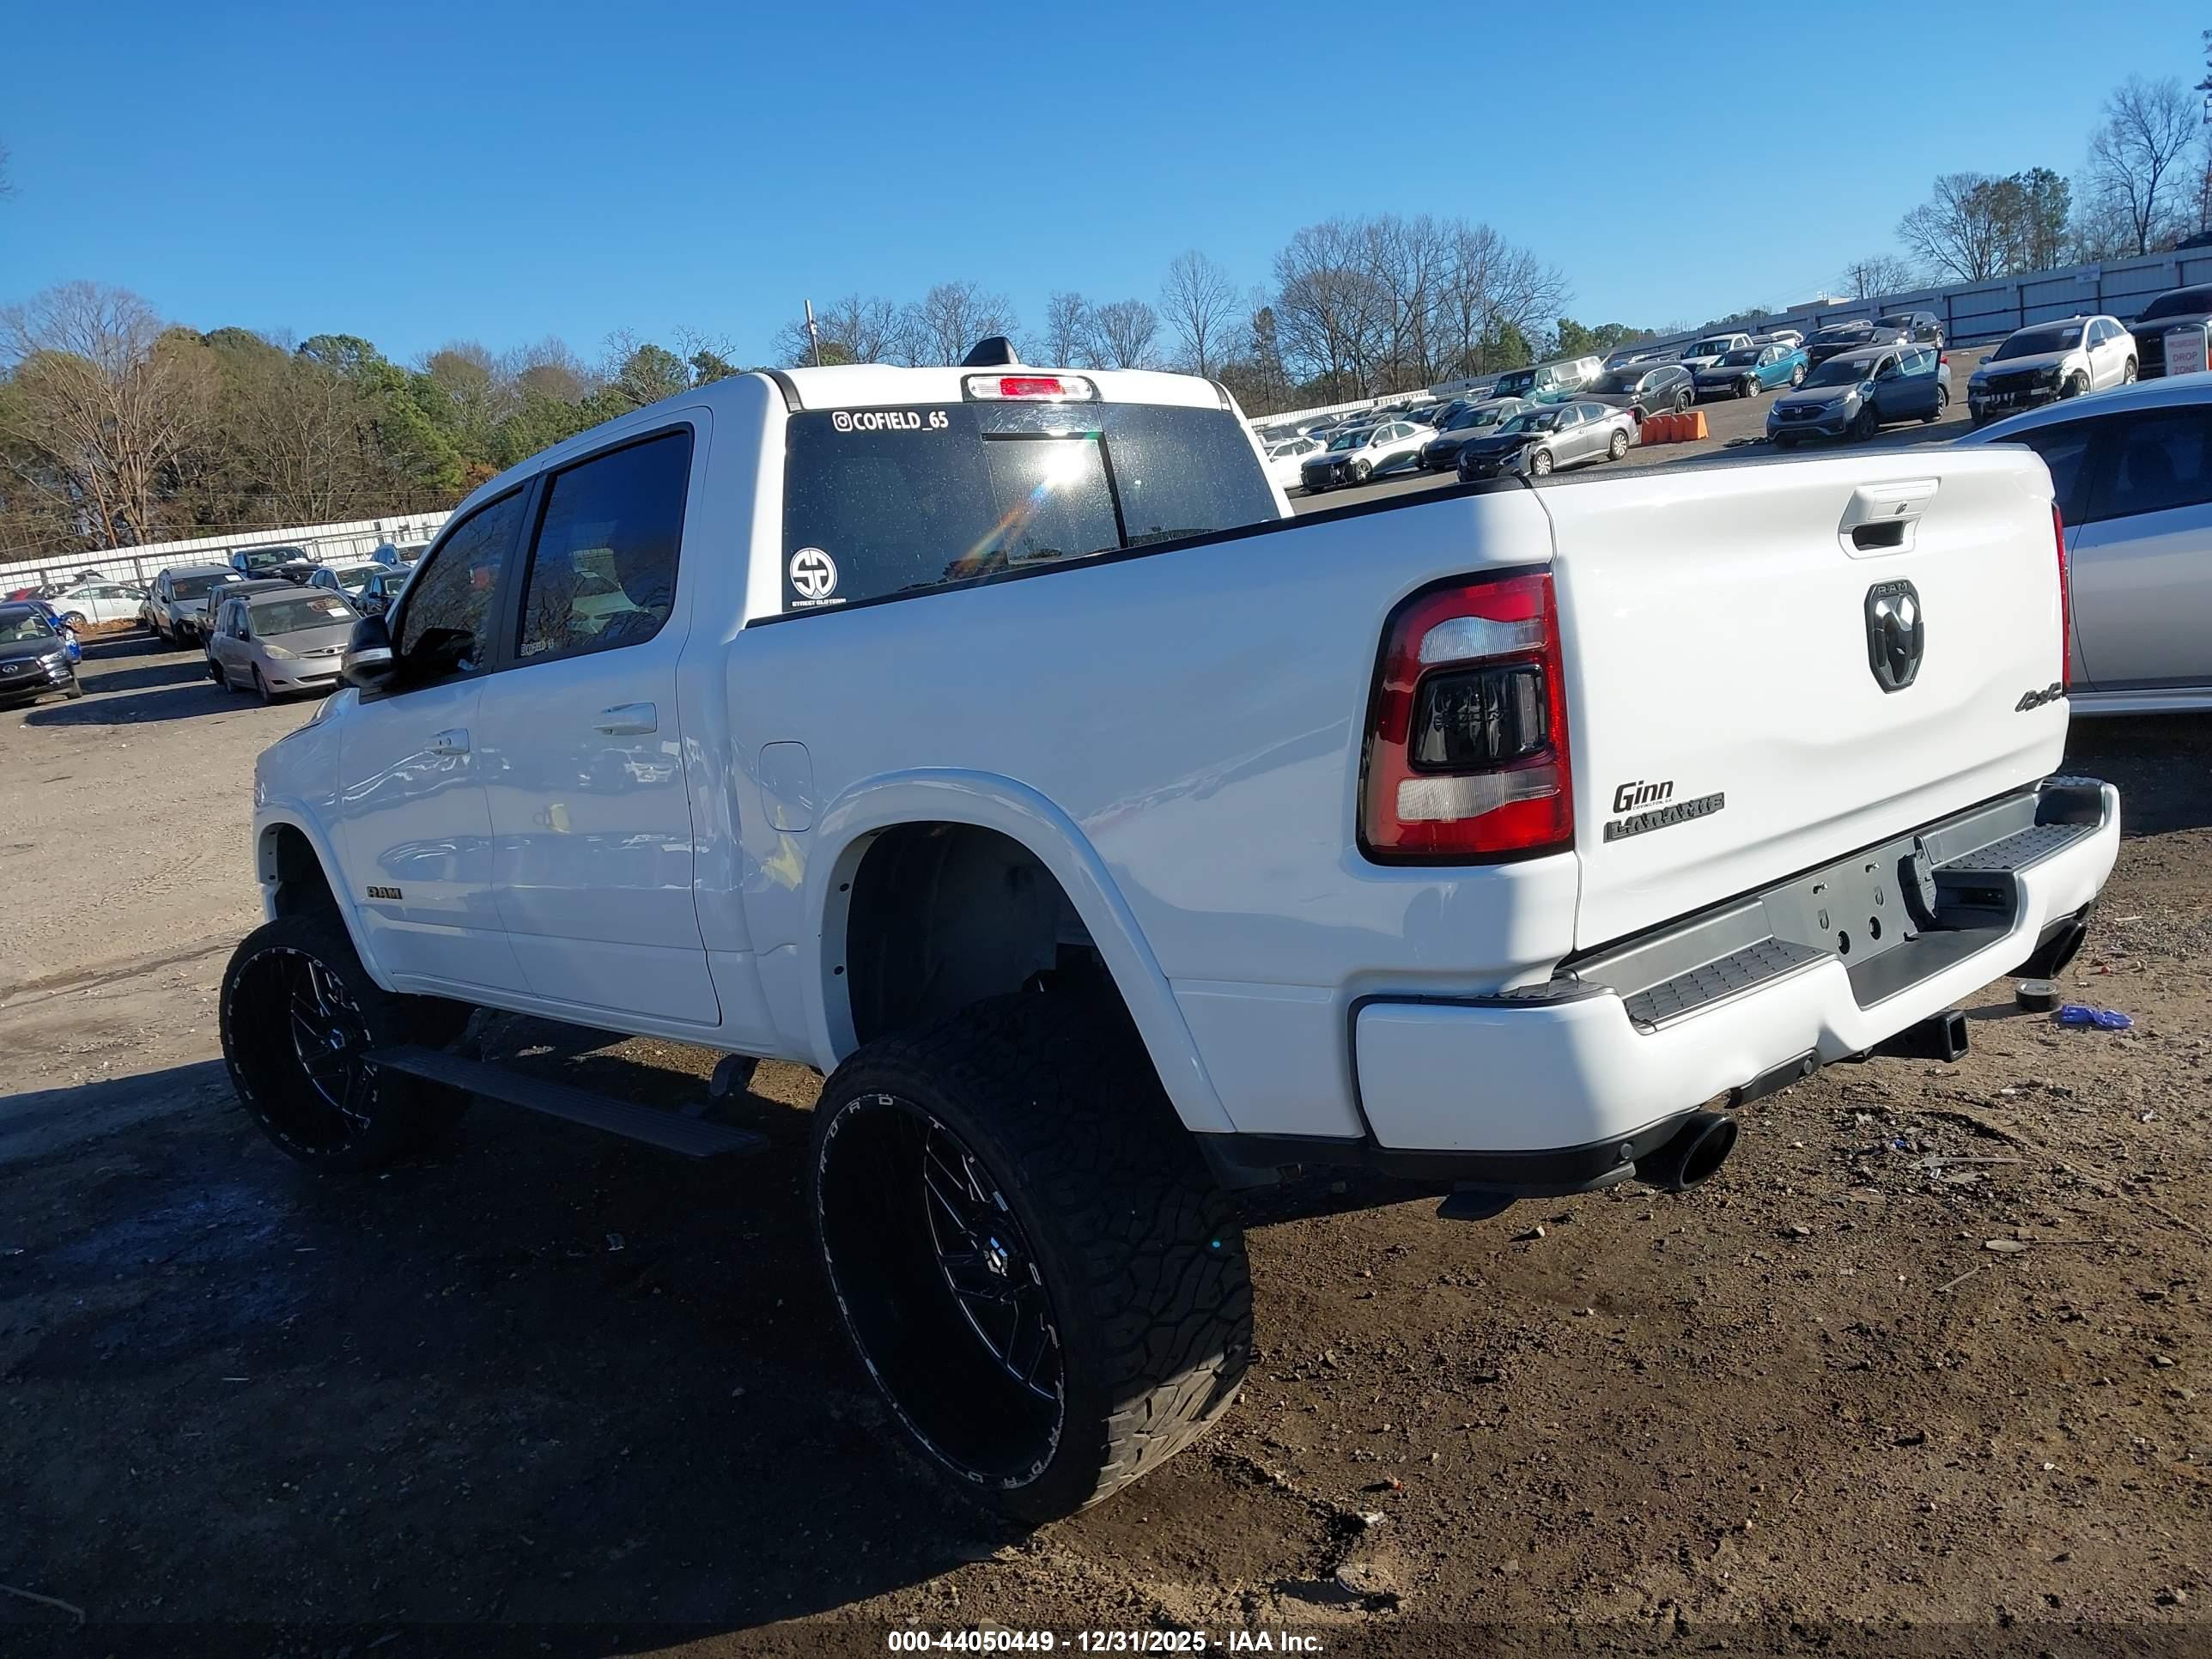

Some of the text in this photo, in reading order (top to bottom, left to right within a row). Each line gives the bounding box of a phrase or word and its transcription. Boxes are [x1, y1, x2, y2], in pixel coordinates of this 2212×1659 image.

[2172, 351, 2198, 362] DROP
[2174, 364, 2198, 375] ZONE
[853, 411, 948, 431] COFIELD_65
[1878, 582, 1909, 595] RAM
[1613, 780, 1674, 814] Ginn
[1604, 791, 1725, 843] LARAMIE
[367, 886, 403, 900] RAM
